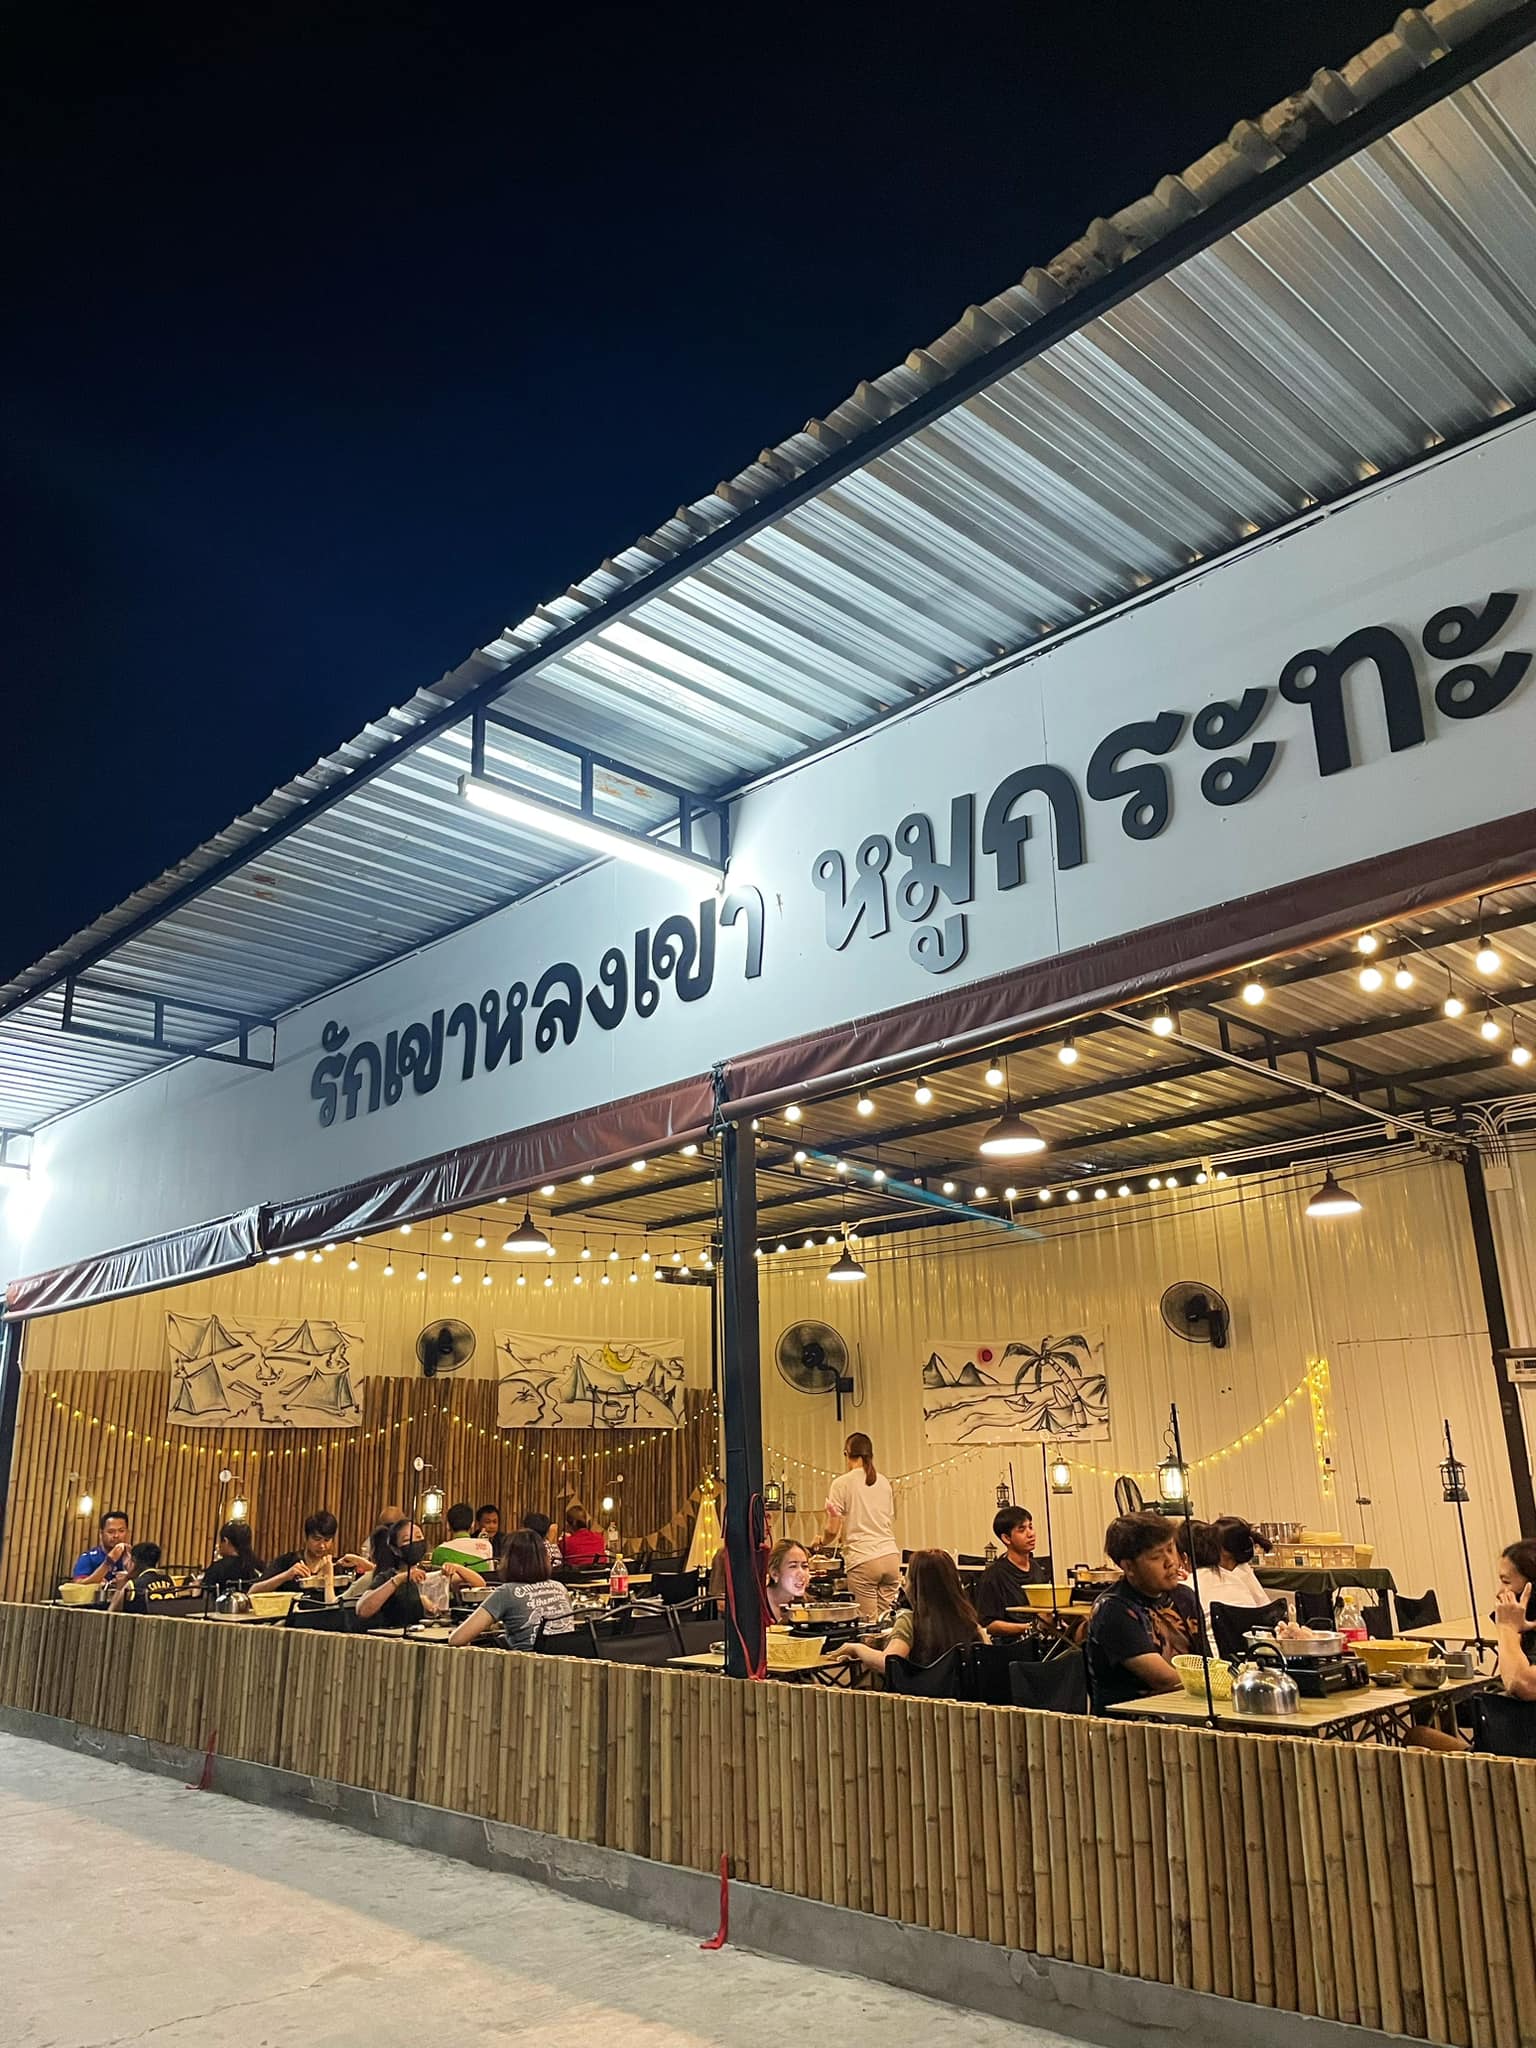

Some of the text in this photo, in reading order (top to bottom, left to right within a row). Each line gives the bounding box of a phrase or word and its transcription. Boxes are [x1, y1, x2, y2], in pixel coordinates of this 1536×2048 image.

[310, 592, 1534, 1128] รักเขาหลงเขา หมูกระทะ
